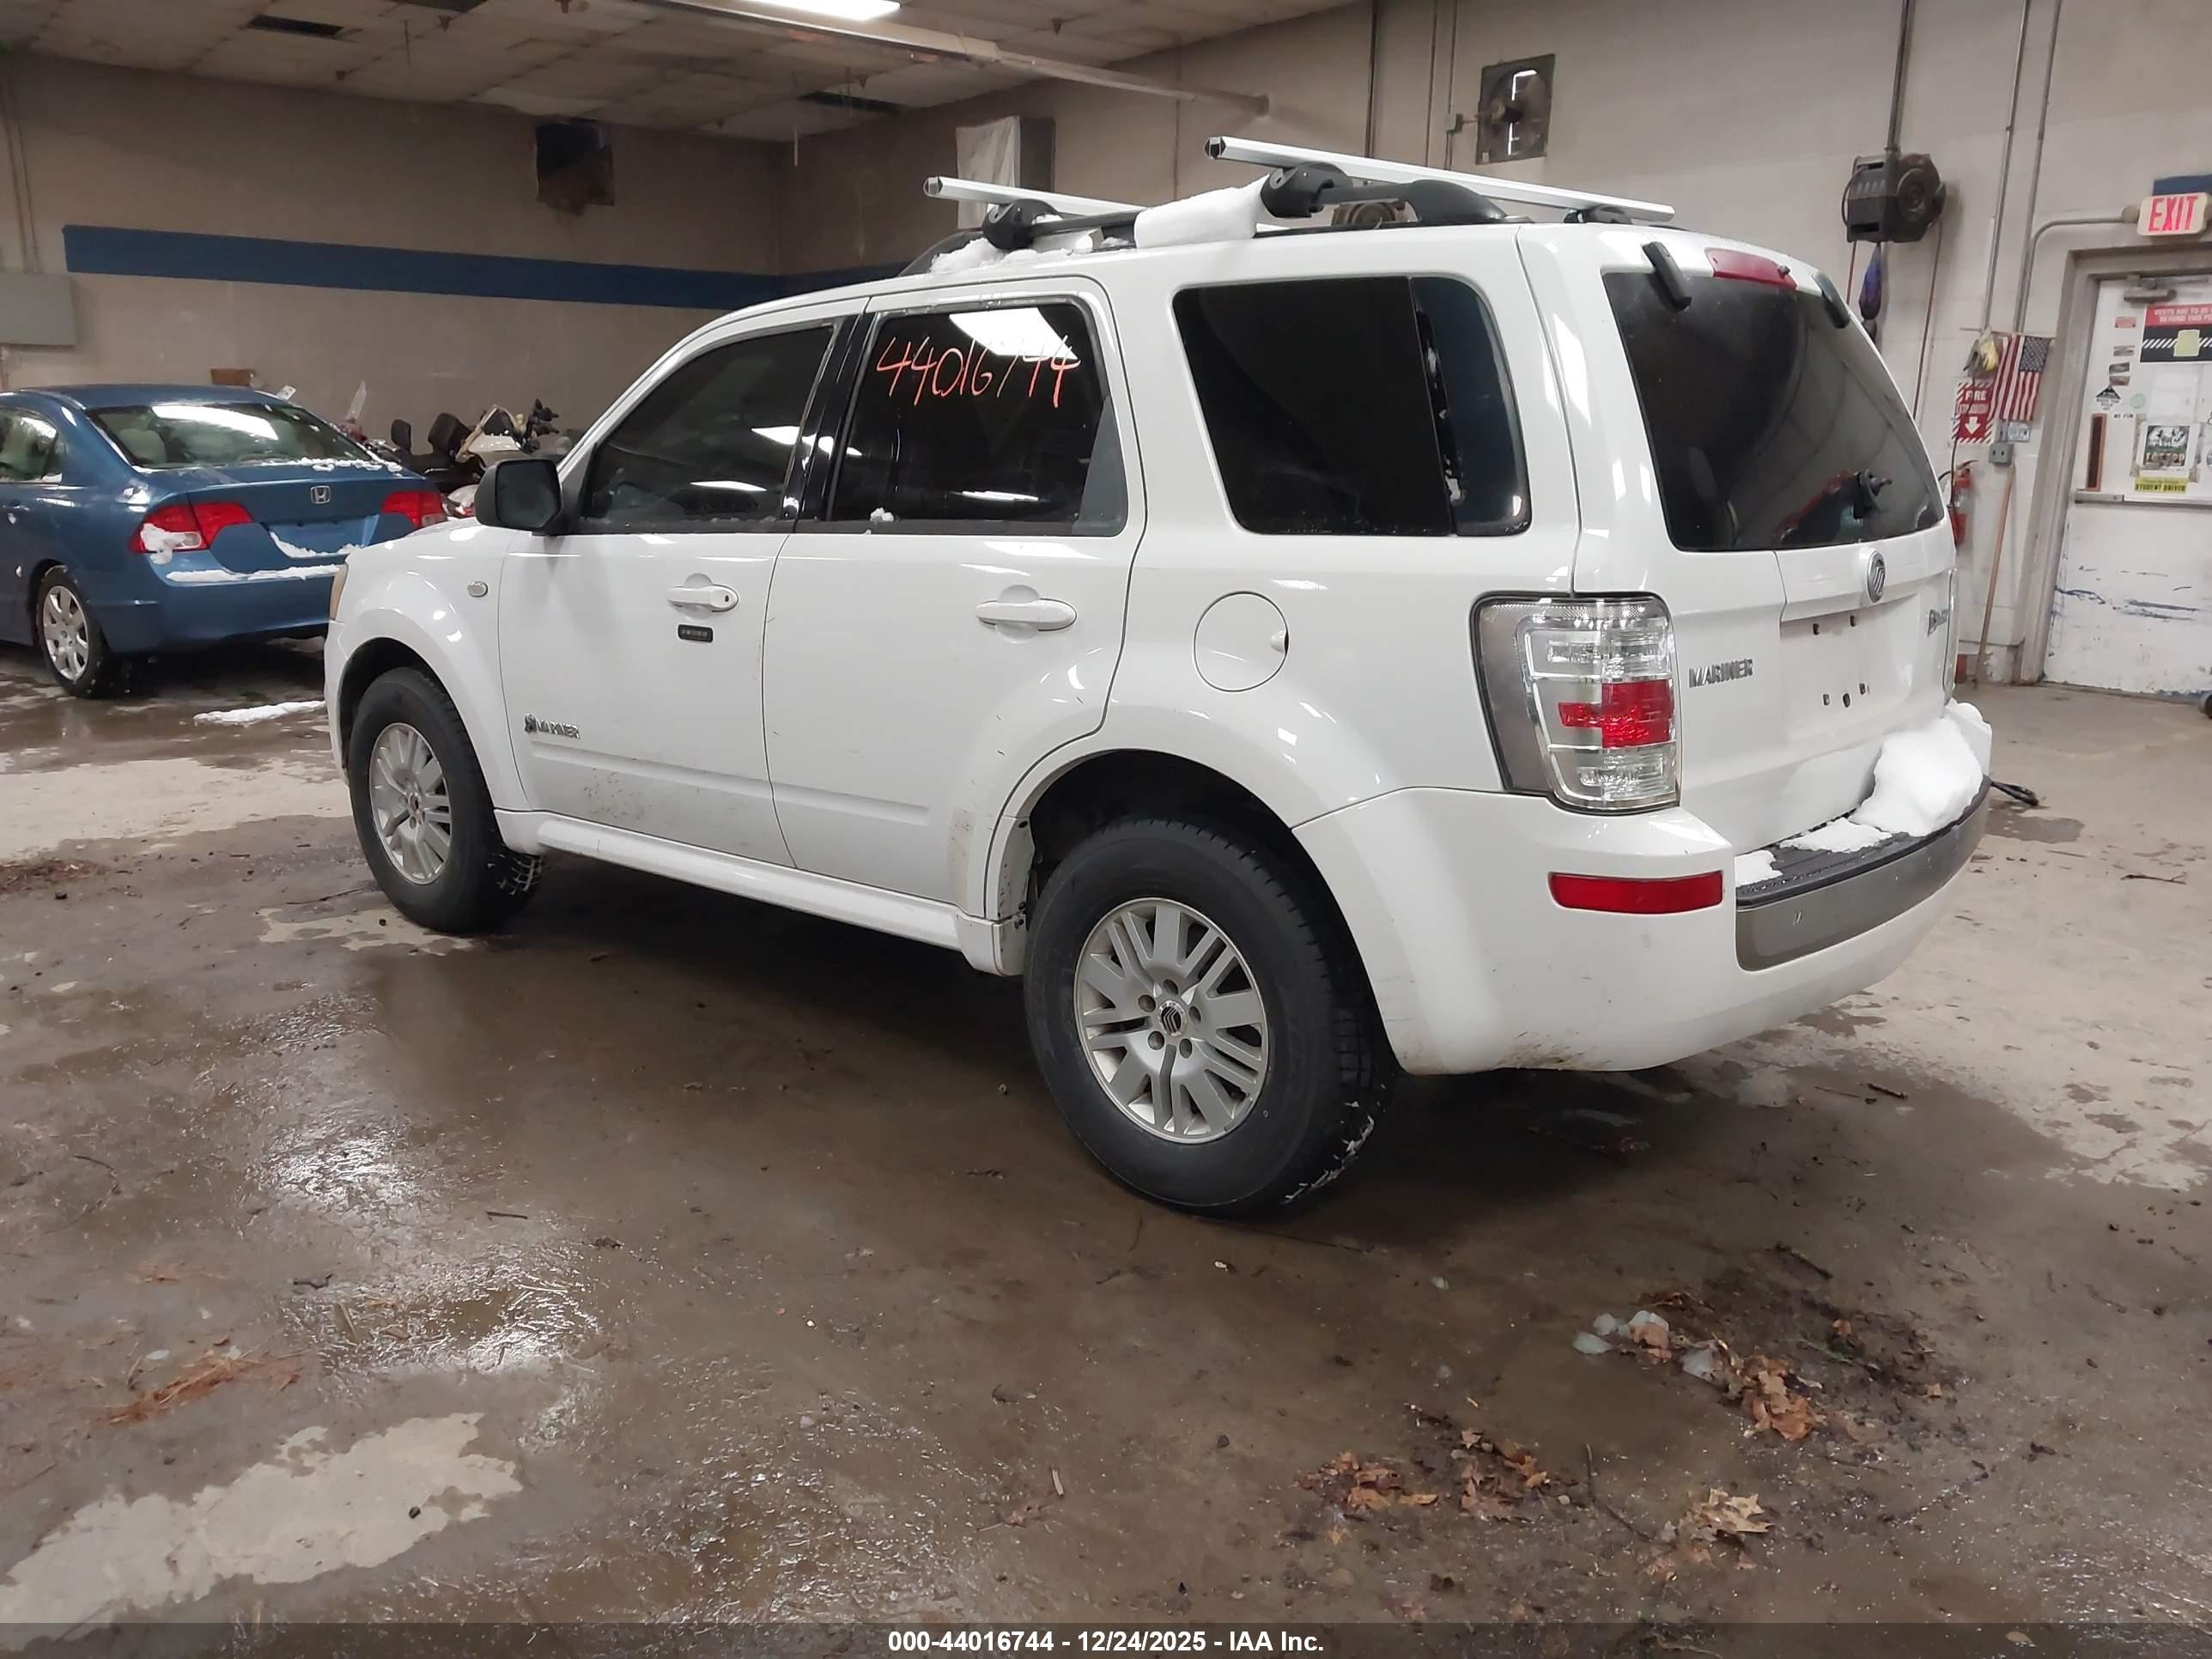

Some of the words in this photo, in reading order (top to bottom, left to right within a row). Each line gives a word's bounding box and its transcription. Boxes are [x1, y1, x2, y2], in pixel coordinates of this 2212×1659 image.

[2148, 195, 2199, 232] EXIT
[1965, 390, 1987, 401] FIRE
[1689, 659, 1753, 688] MARINER
